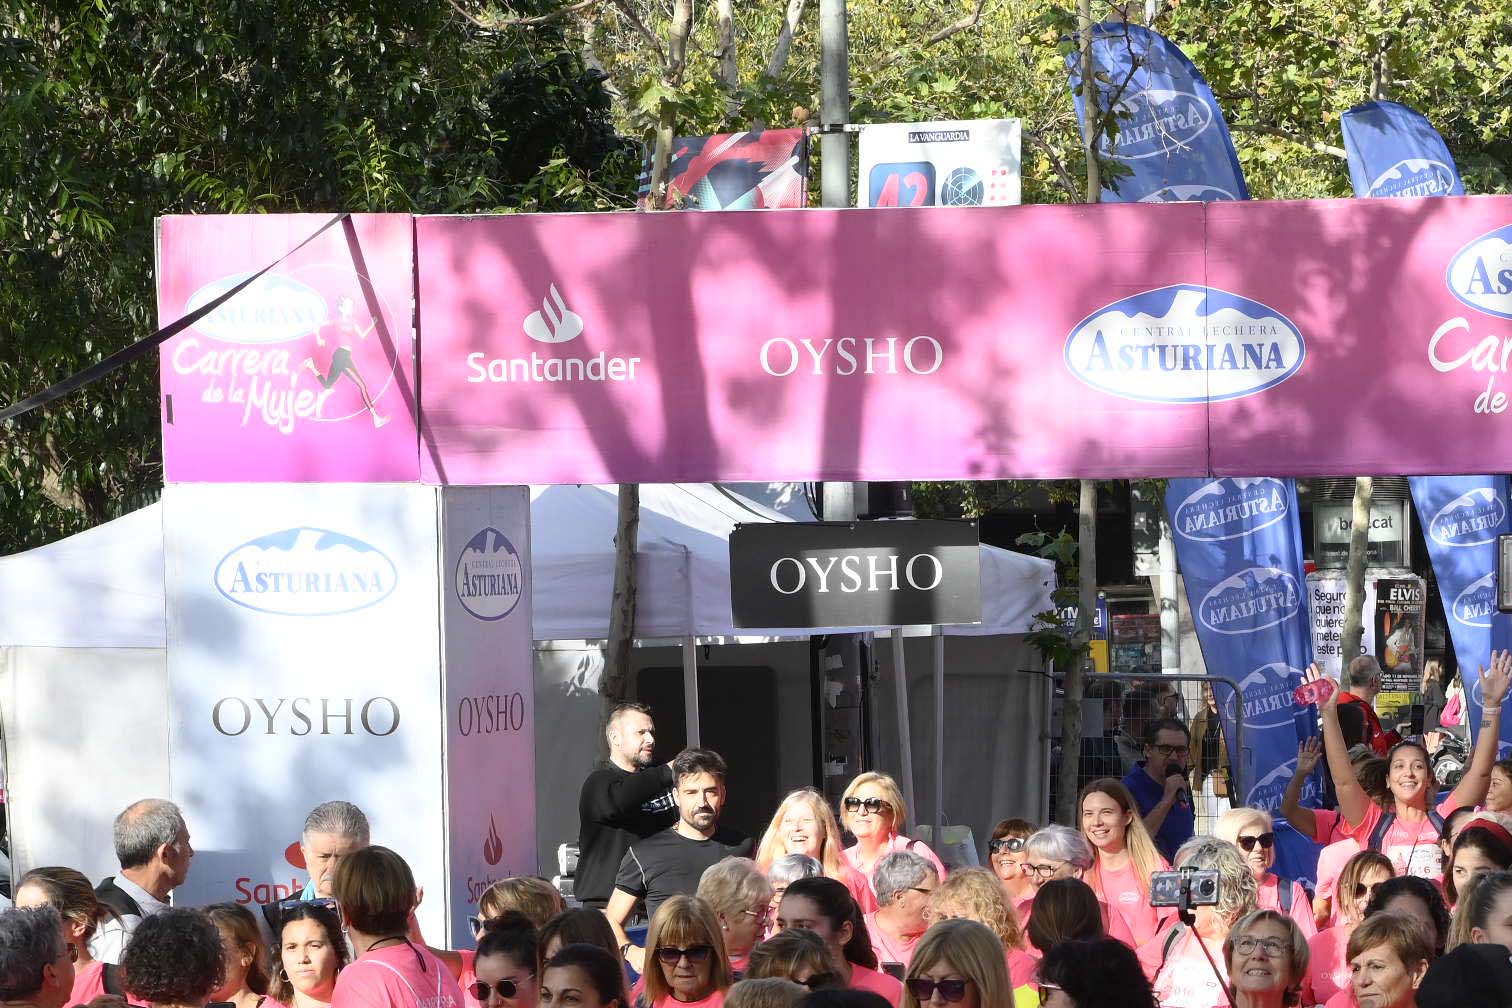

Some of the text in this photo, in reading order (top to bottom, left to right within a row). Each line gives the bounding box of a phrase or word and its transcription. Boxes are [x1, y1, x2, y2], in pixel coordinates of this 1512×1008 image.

[920, 131, 969, 142] VANGUARDIA
[172, 338, 290, 375] Carrera
[467, 352, 640, 383] Santander
[759, 335, 942, 377] OYSHO
[1085, 330, 1286, 372] ASTURIANA
[202, 374, 335, 434] de la Mujer
[1473, 376, 1508, 414] de
[230, 561, 385, 594] ASTURIANA
[461, 565, 519, 599] ASTURIANA
[769, 553, 945, 595] OYSHO
[1316, 606, 1332, 618] que
[1390, 588, 1420, 601] ELVIS
[1316, 618, 1344, 629] quiere
[1317, 645, 1336, 655] este
[212, 696, 401, 736] OYSHO
[458, 691, 525, 737] OYSHO
